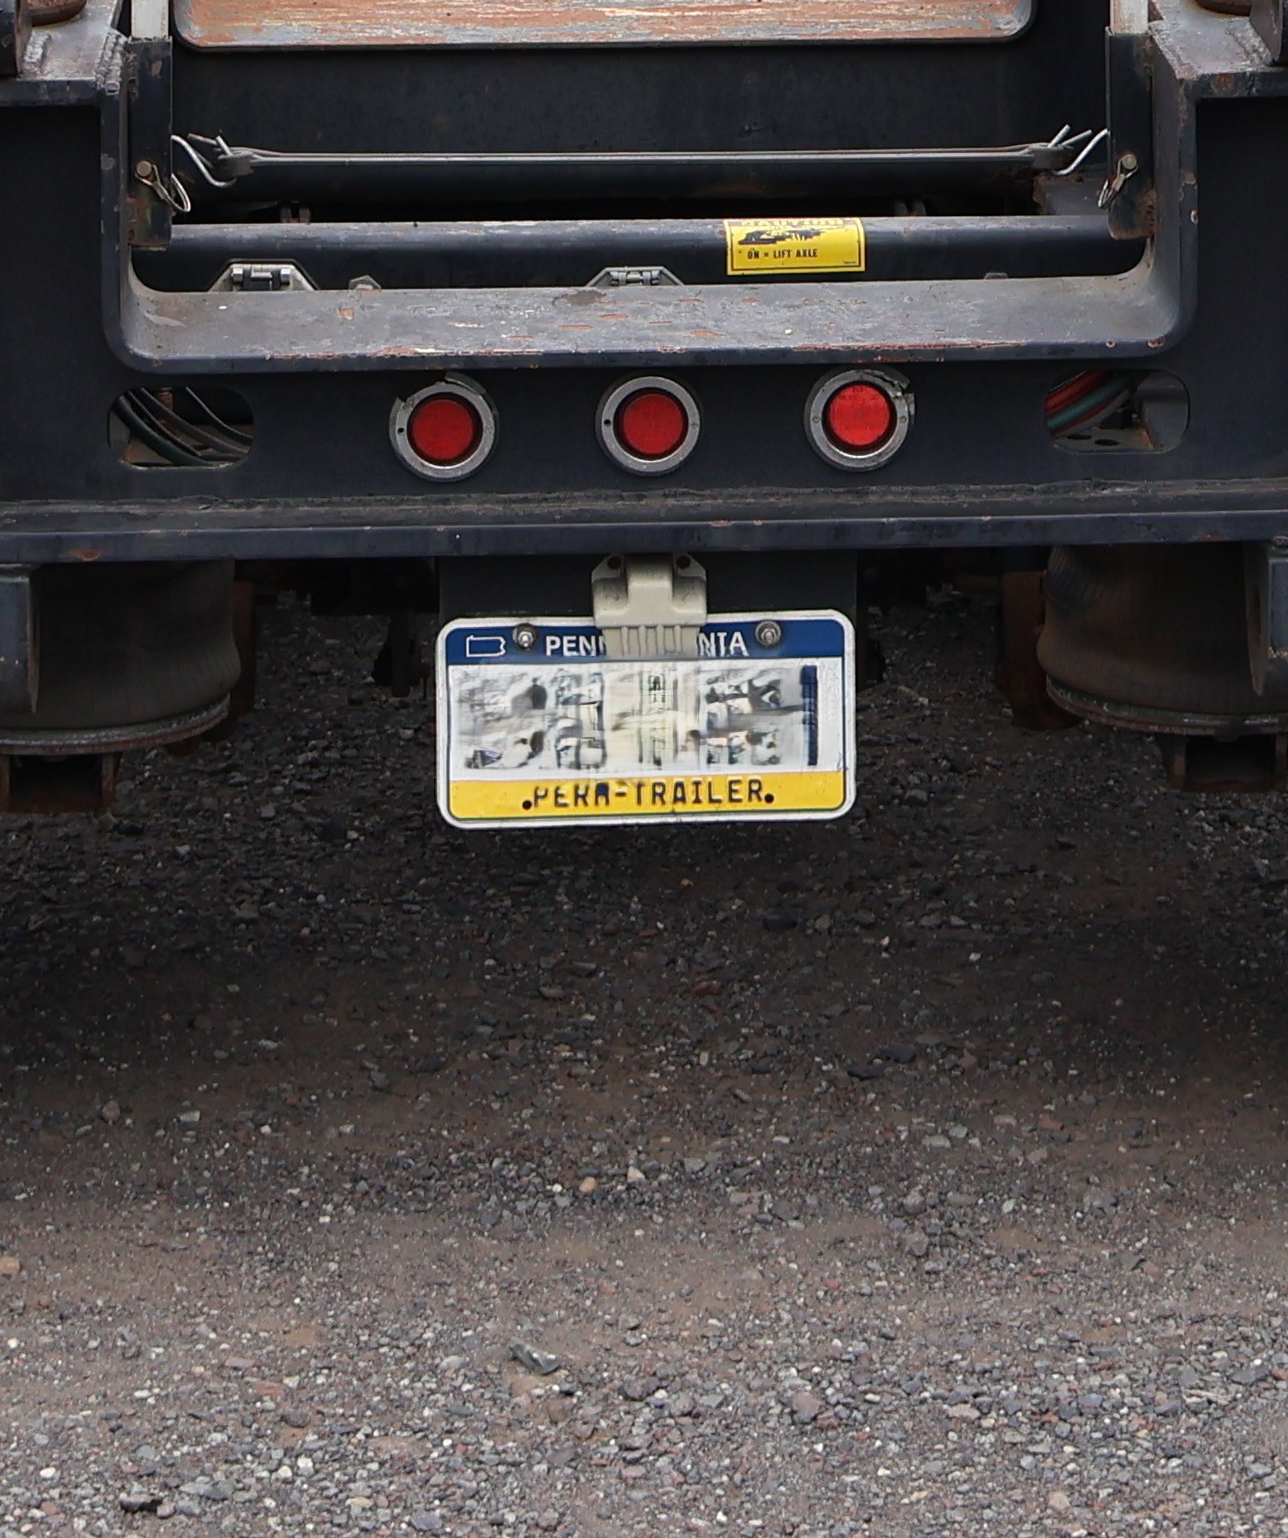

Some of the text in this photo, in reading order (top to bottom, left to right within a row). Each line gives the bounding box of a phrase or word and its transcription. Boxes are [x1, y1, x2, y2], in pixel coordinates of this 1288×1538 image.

[747, 249, 760, 260] ON
[773, 249, 792, 259] LIFT
[795, 248, 818, 259] AXLE
